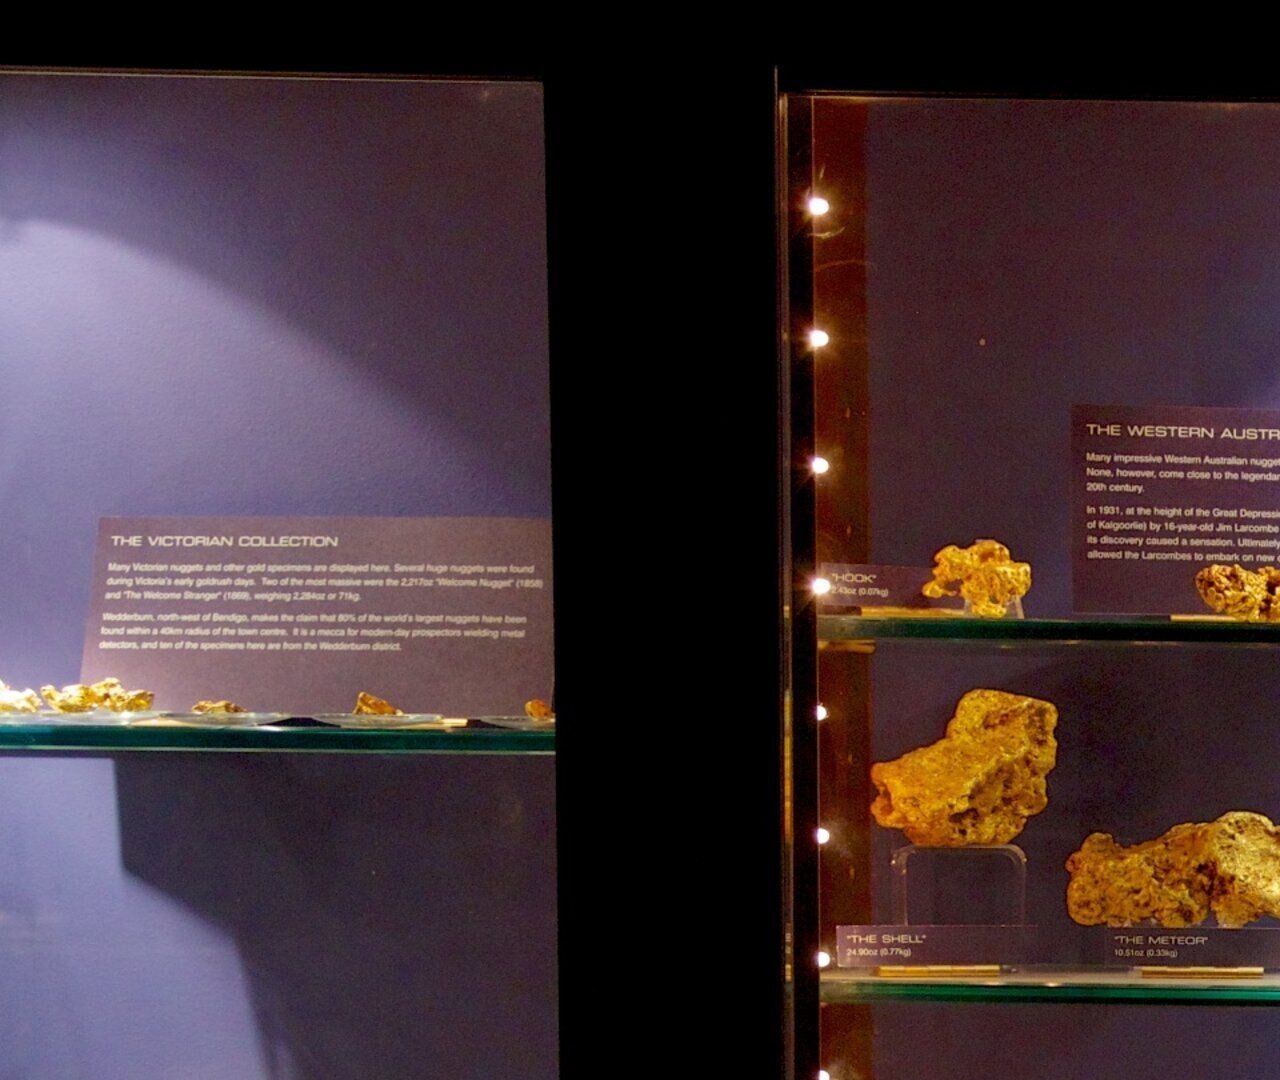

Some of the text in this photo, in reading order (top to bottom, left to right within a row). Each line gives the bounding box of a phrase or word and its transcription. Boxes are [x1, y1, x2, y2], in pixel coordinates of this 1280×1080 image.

[1086, 424, 1121, 436] THE
[1126, 425, 1215, 439] WESTERN
[111, 535, 339, 547] THE VICTORIAN COLLECTION
